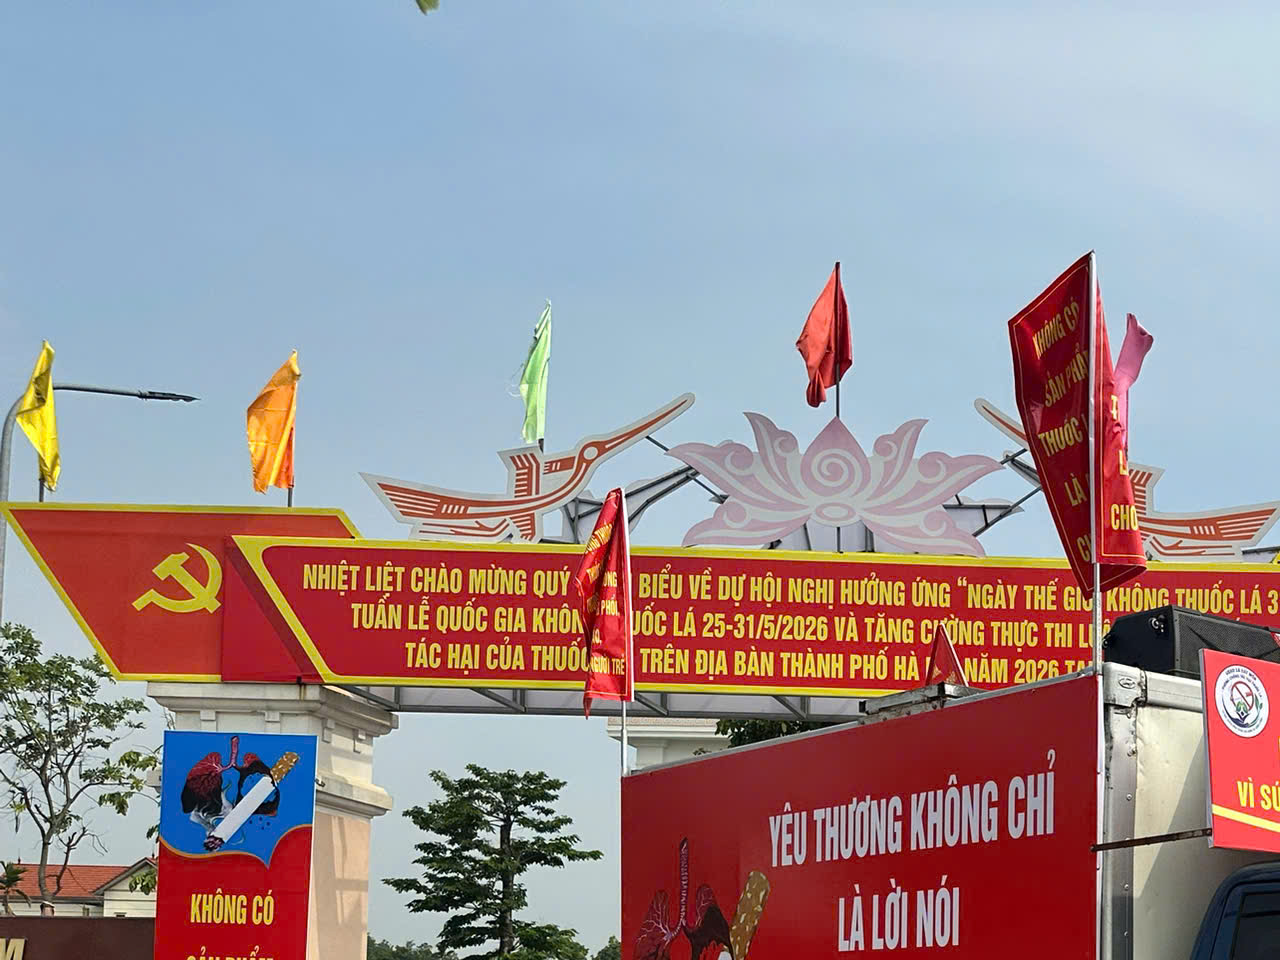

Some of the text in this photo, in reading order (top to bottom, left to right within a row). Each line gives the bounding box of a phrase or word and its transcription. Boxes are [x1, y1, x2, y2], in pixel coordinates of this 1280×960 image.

[1066, 342, 1088, 388] PHẨ
[1038, 416, 1083, 457] THUỐC
[303, 560, 360, 596] NHIỆT
[366, 561, 405, 597] LIỆT
[410, 563, 462, 594] CHÀO
[468, 564, 526, 595] MỪNG
[533, 566, 570, 596] QUÝ
[639, 564, 682, 599] BIỂU
[689, 567, 712, 600] VỀ
[718, 574, 747, 606] DỰ
[750, 572, 782, 607] HỘI
[788, 578, 834, 609] NGHỊ
[840, 572, 905, 606] HƯỞNG
[912, 576, 950, 608] ỨNG
[1024, 578, 1058, 610] THẾ
[1106, 582, 1170, 612] KHÔNG
[1175, 580, 1234, 614] THUỐC
[1240, 584, 1262, 614] LÁ
[352, 594, 402, 630] TUẦN
[408, 596, 430, 630] LỄ
[436, 597, 488, 634] QUỐC
[494, 607, 526, 634] GIA
[532, 604, 584, 634] KHÔN
[632, 602, 667, 636] UỐC
[673, 606, 696, 637] LÁ
[702, 612, 828, 641] 25-31/5/2026
[834, 612, 859, 642] VÀ
[864, 613, 914, 645] TĂNG
[990, 618, 1038, 652] THỰC
[1044, 622, 1072, 648] THI
[406, 637, 441, 669] TÁC
[448, 643, 480, 675] HẠI
[486, 636, 525, 671] CỦA
[532, 637, 588, 672] THUỐC
[640, 643, 690, 675] TRÊN
[695, 648, 728, 680] ĐỊA
[734, 647, 774, 677] BÀN
[780, 647, 844, 679] THÀNH
[850, 646, 890, 680] PHỐ
[894, 650, 920, 681] HÀ
[964, 652, 1008, 684] NĂM
[1014, 658, 1059, 684] 2026
[768, 749, 1056, 867] YÊU THƯƠNG KHÔNG CHỈ
[1237, 776, 1254, 808] VÌ
[190, 888, 274, 926] KHÔNG CÓ
[837, 874, 960, 952] LÀ LỜI NÓI
